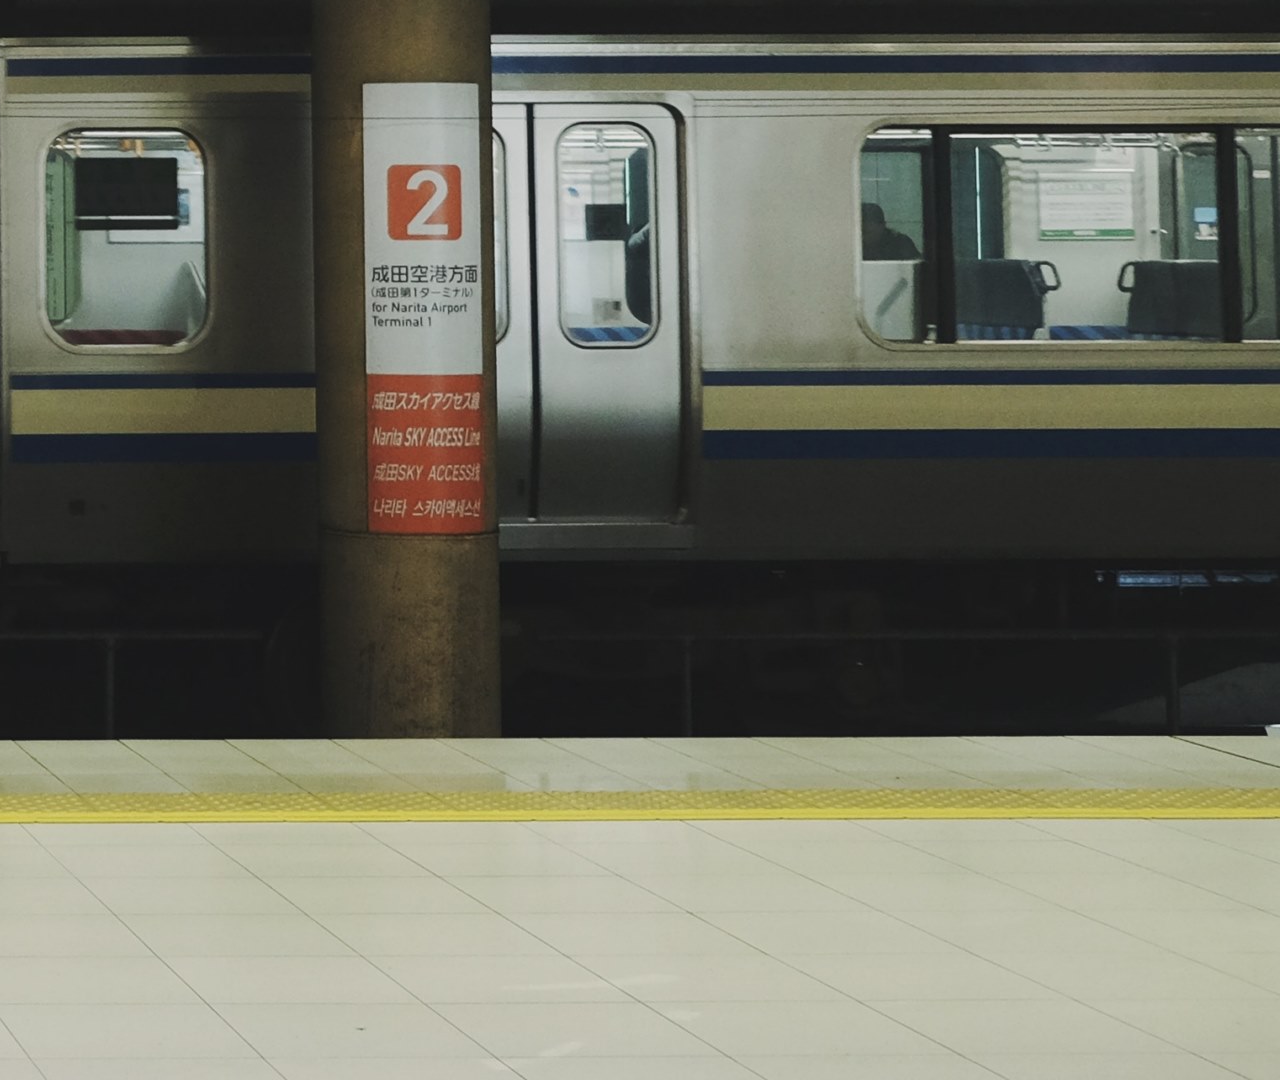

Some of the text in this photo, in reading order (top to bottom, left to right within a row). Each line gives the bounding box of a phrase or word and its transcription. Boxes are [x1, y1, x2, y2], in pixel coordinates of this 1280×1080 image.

[406, 169, 449, 235] 2
[371, 264, 478, 283] 成田空港方面
[372, 301, 468, 315] for Narita Airport
[372, 315, 423, 327] Terminal
[371, 391, 480, 411] 成田スカイアクセス線
[372, 427, 481, 448] Narita SKY ACCESS Line
[373, 498, 407, 518] 나리타
